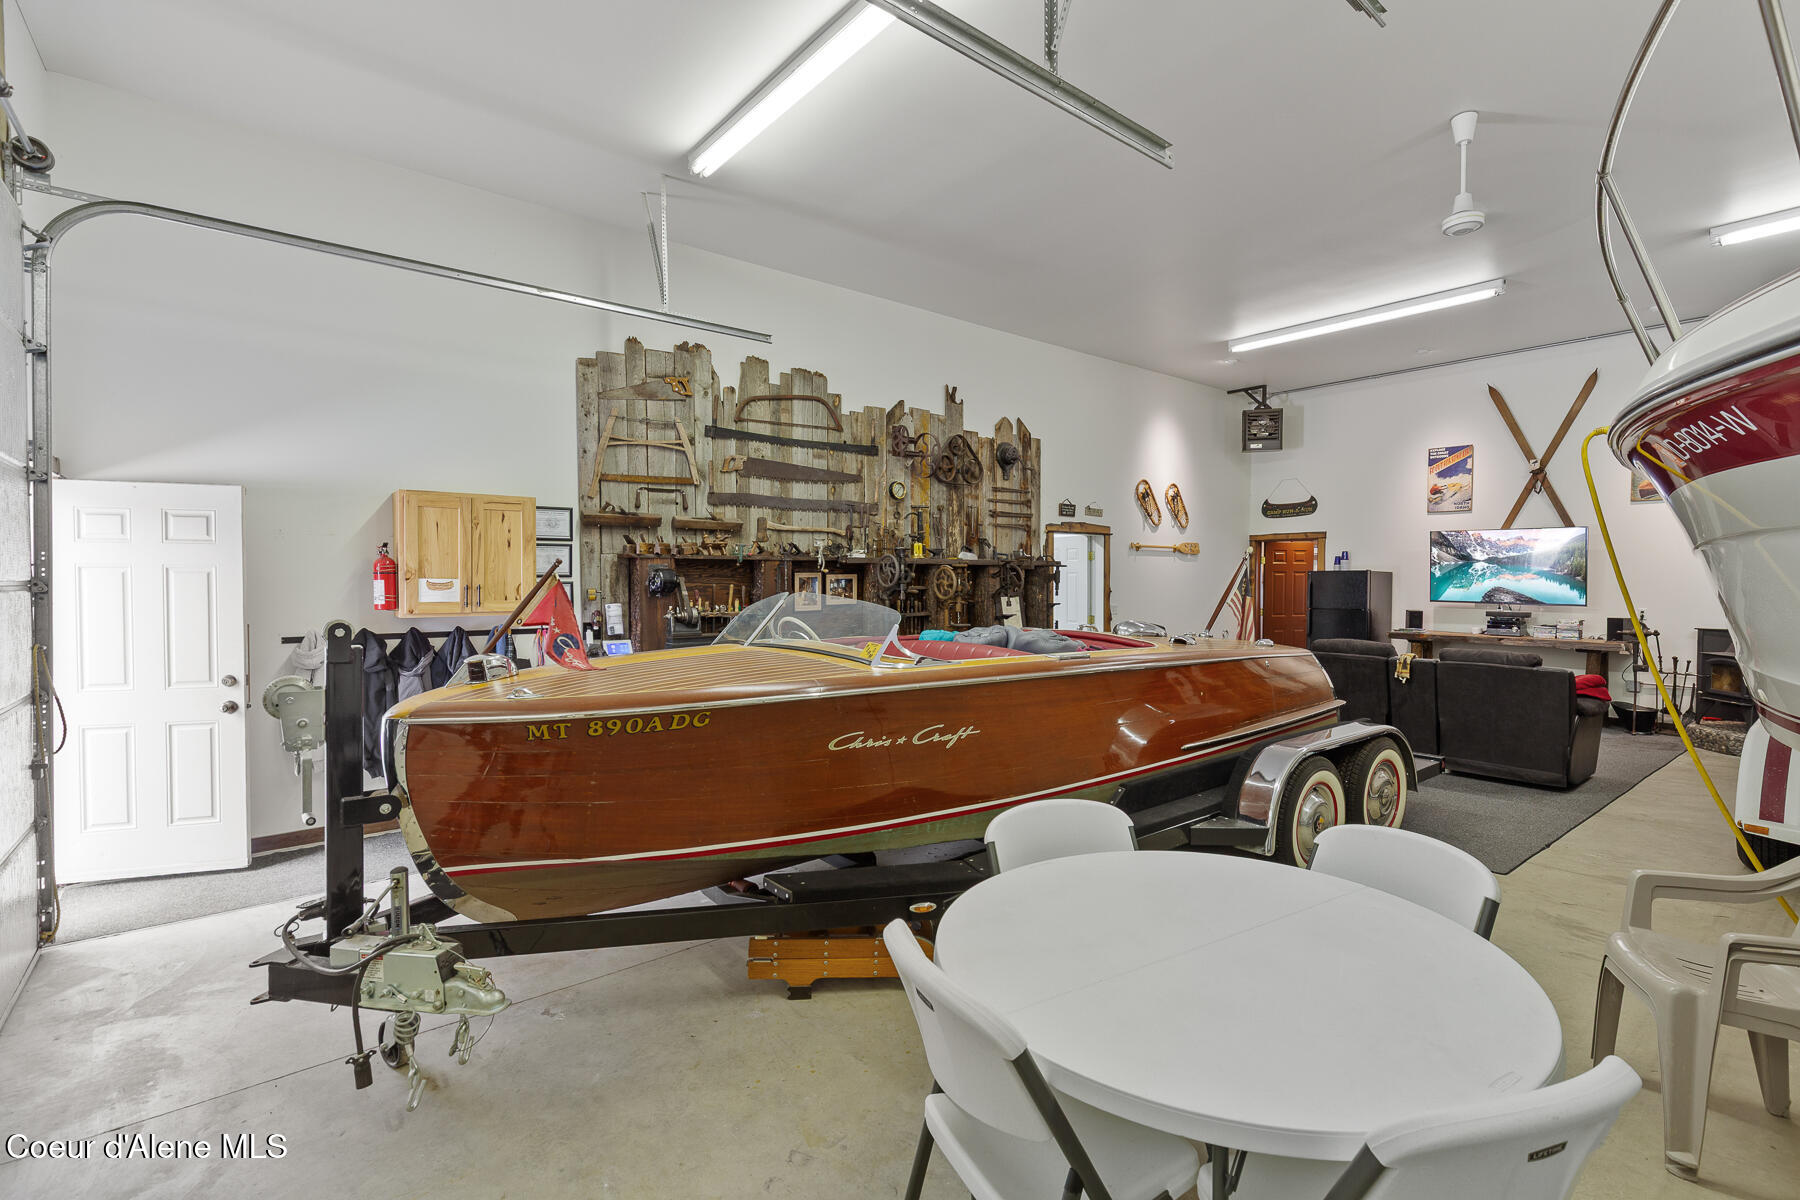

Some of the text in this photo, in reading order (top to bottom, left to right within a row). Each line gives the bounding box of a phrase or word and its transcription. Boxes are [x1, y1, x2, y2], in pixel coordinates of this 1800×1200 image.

[527, 723, 571, 741] MT
[828, 724, 981, 751] Chris Craft
